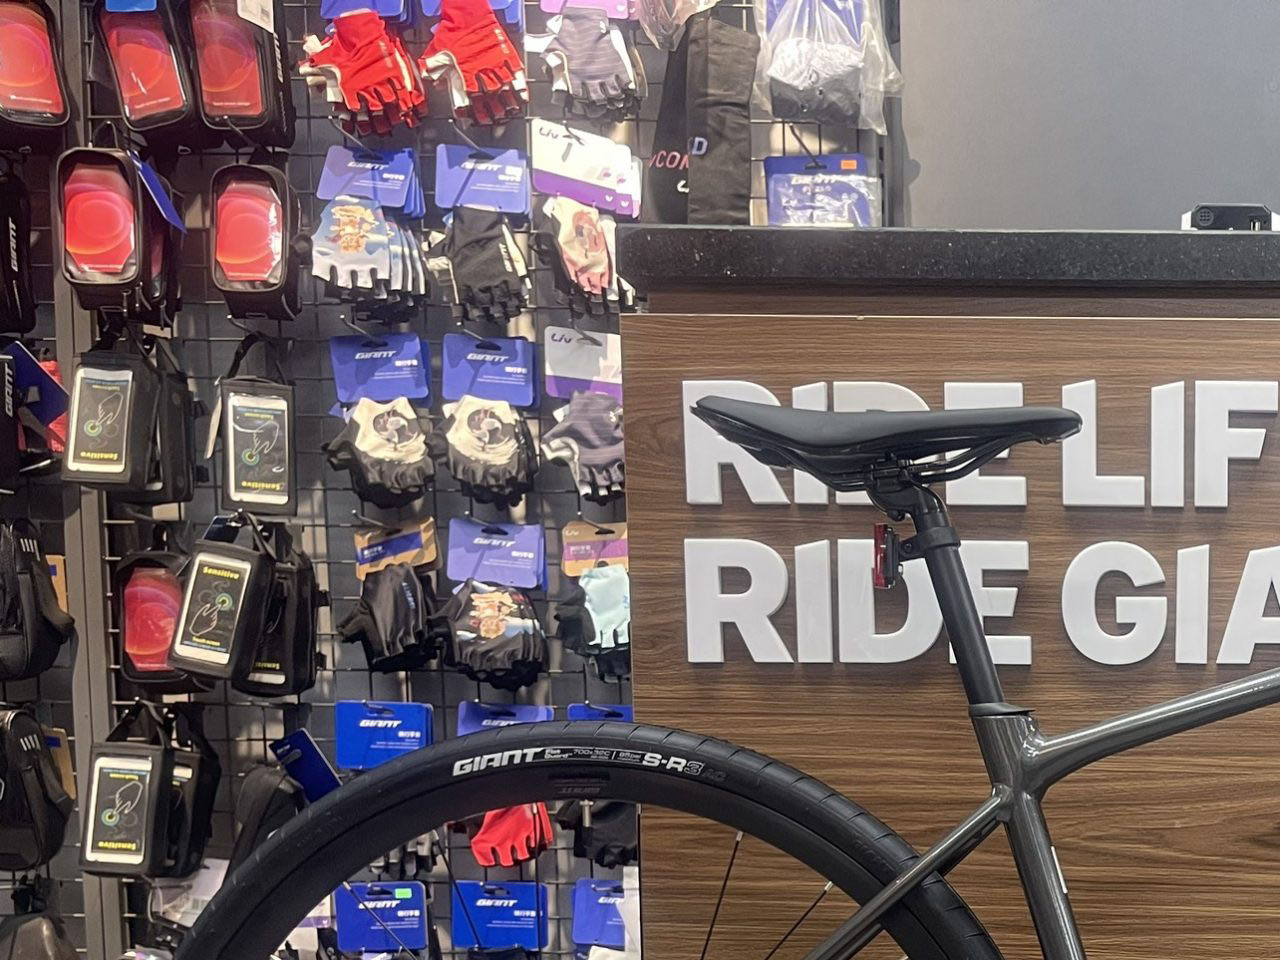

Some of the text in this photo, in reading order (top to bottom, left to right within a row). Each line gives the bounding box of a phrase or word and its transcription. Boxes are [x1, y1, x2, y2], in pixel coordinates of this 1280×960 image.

[9, 217, 17, 272] GIANT
[551, 333, 573, 344] Liv
[355, 351, 397, 361] GIANT
[467, 353, 509, 363] GIANT
[5, 362, 13, 417] GIANT
[473, 537, 516, 547] GIANT
[202, 566, 240, 580] Sensitive
[684, 539, 1032, 665] RIDE
[359, 719, 401, 729] GIANT
[452, 748, 546, 777] GIANT
[359, 900, 401, 909] GIANT
[476, 898, 518, 908] GIANT
